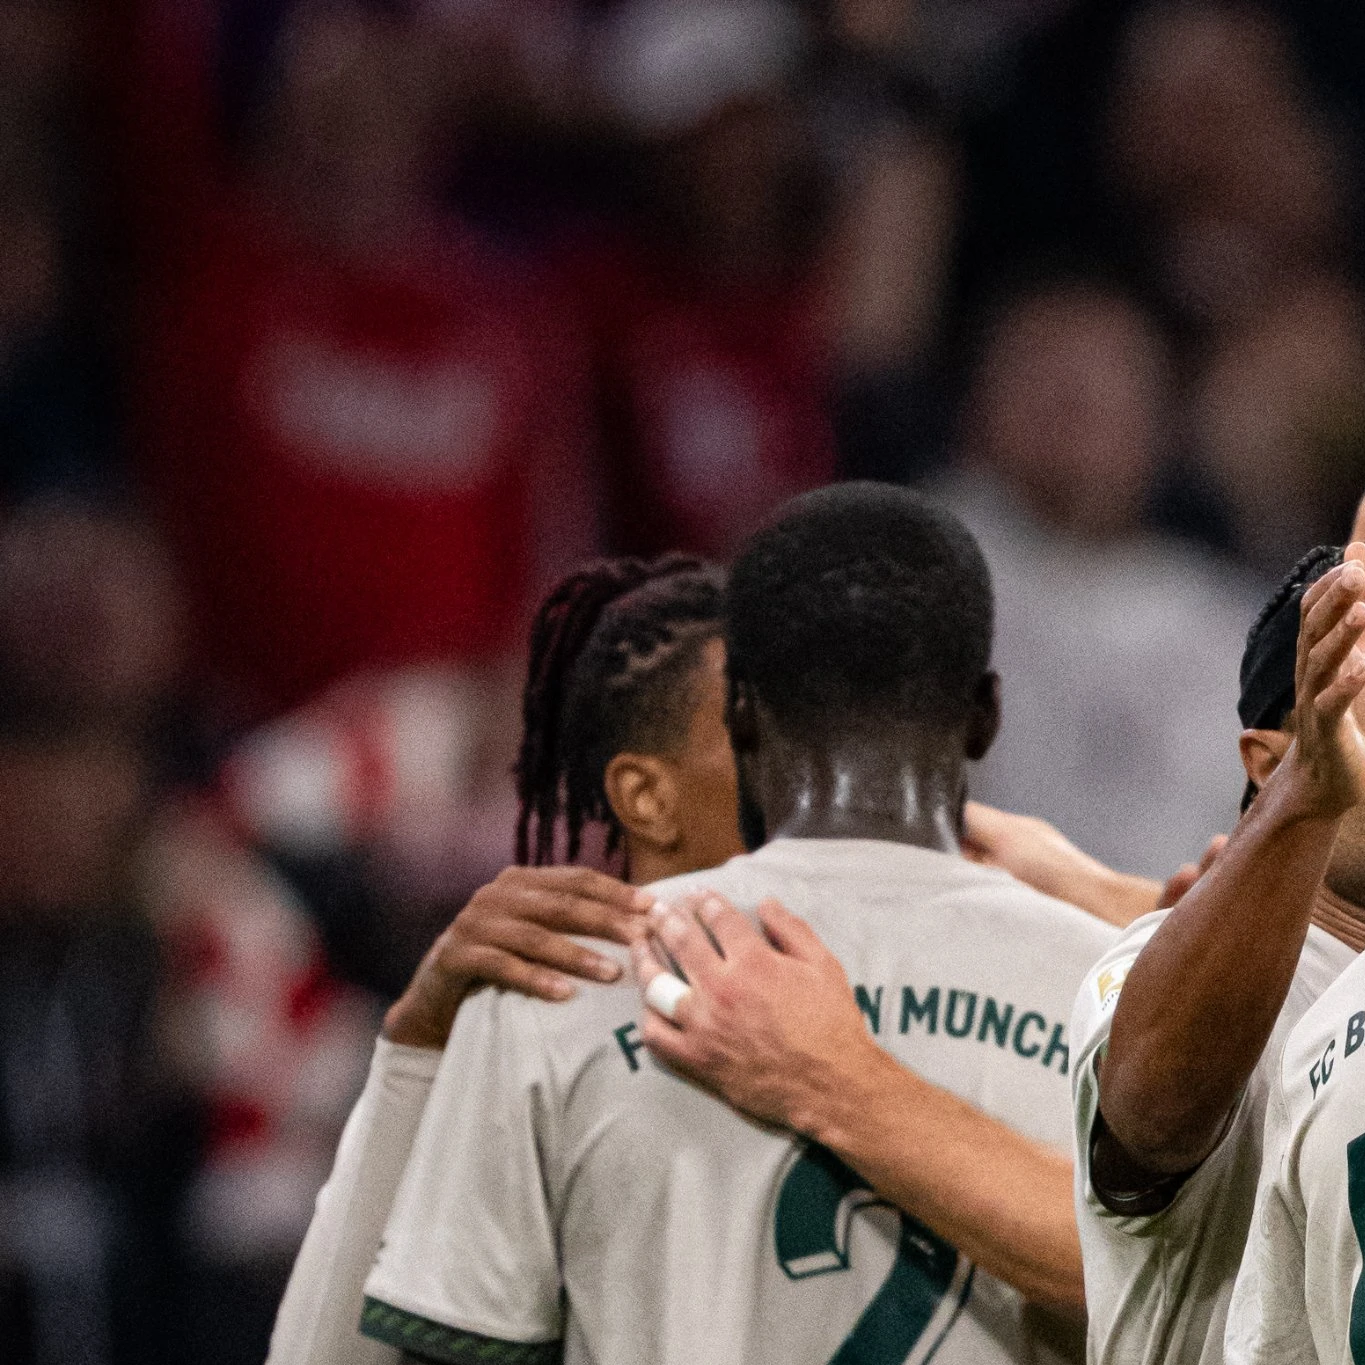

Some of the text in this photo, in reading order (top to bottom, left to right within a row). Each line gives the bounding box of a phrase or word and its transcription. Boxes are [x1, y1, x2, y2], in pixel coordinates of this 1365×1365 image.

[613, 1021, 645, 1072] F
[900, 985, 1069, 1075] MÜNCH
[1309, 1038, 1336, 1100] FC
